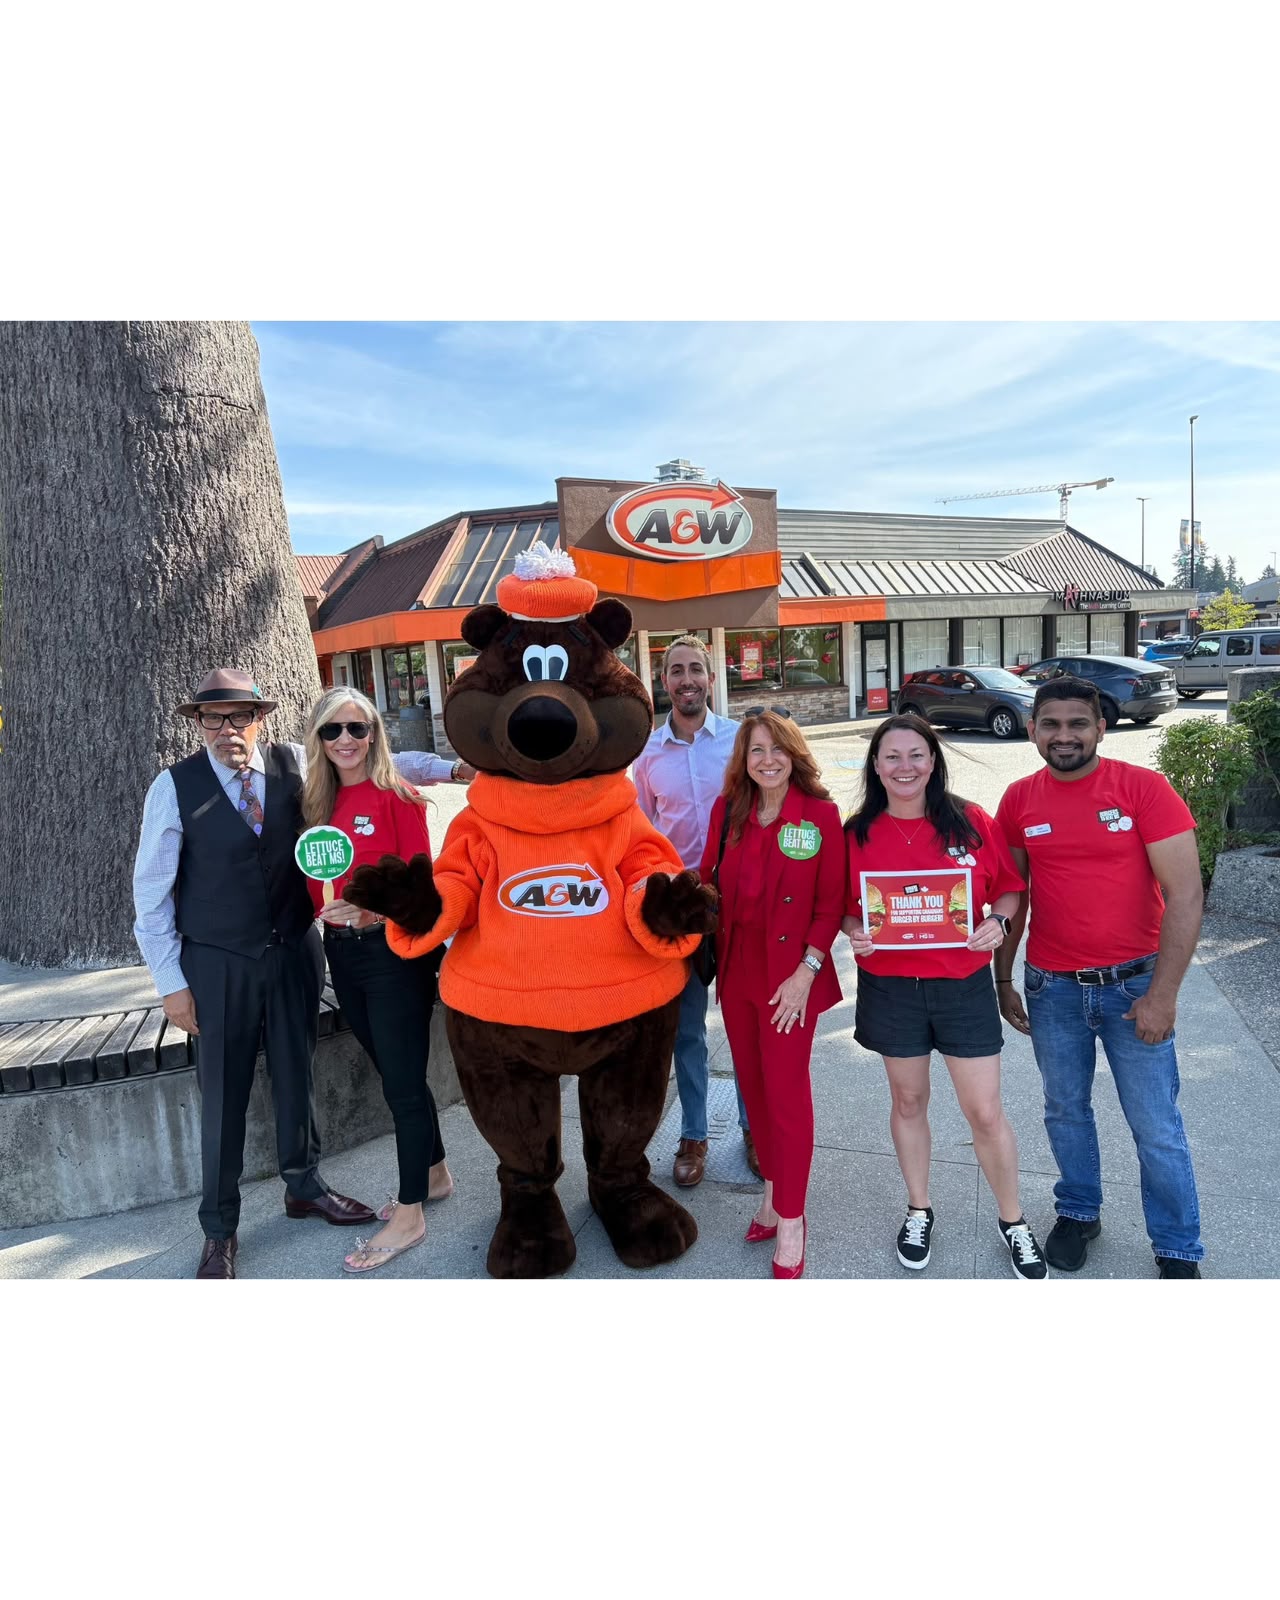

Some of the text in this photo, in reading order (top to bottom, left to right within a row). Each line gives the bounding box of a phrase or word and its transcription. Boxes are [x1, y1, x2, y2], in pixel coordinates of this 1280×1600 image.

[633, 508, 744, 545] A&W
[1055, 583, 1131, 611] MATHNASIUM
[1100, 602, 1117, 610] Learning
[784, 828, 817, 840] LETTUCE
[304, 839, 344, 855] LETTUCE
[783, 838, 816, 850] BEAT MS!
[305, 849, 346, 867] BEAT MS!
[512, 883, 603, 907] A&W
[890, 895, 944, 909] THANK YOU
[913, 915, 920, 923] BY
